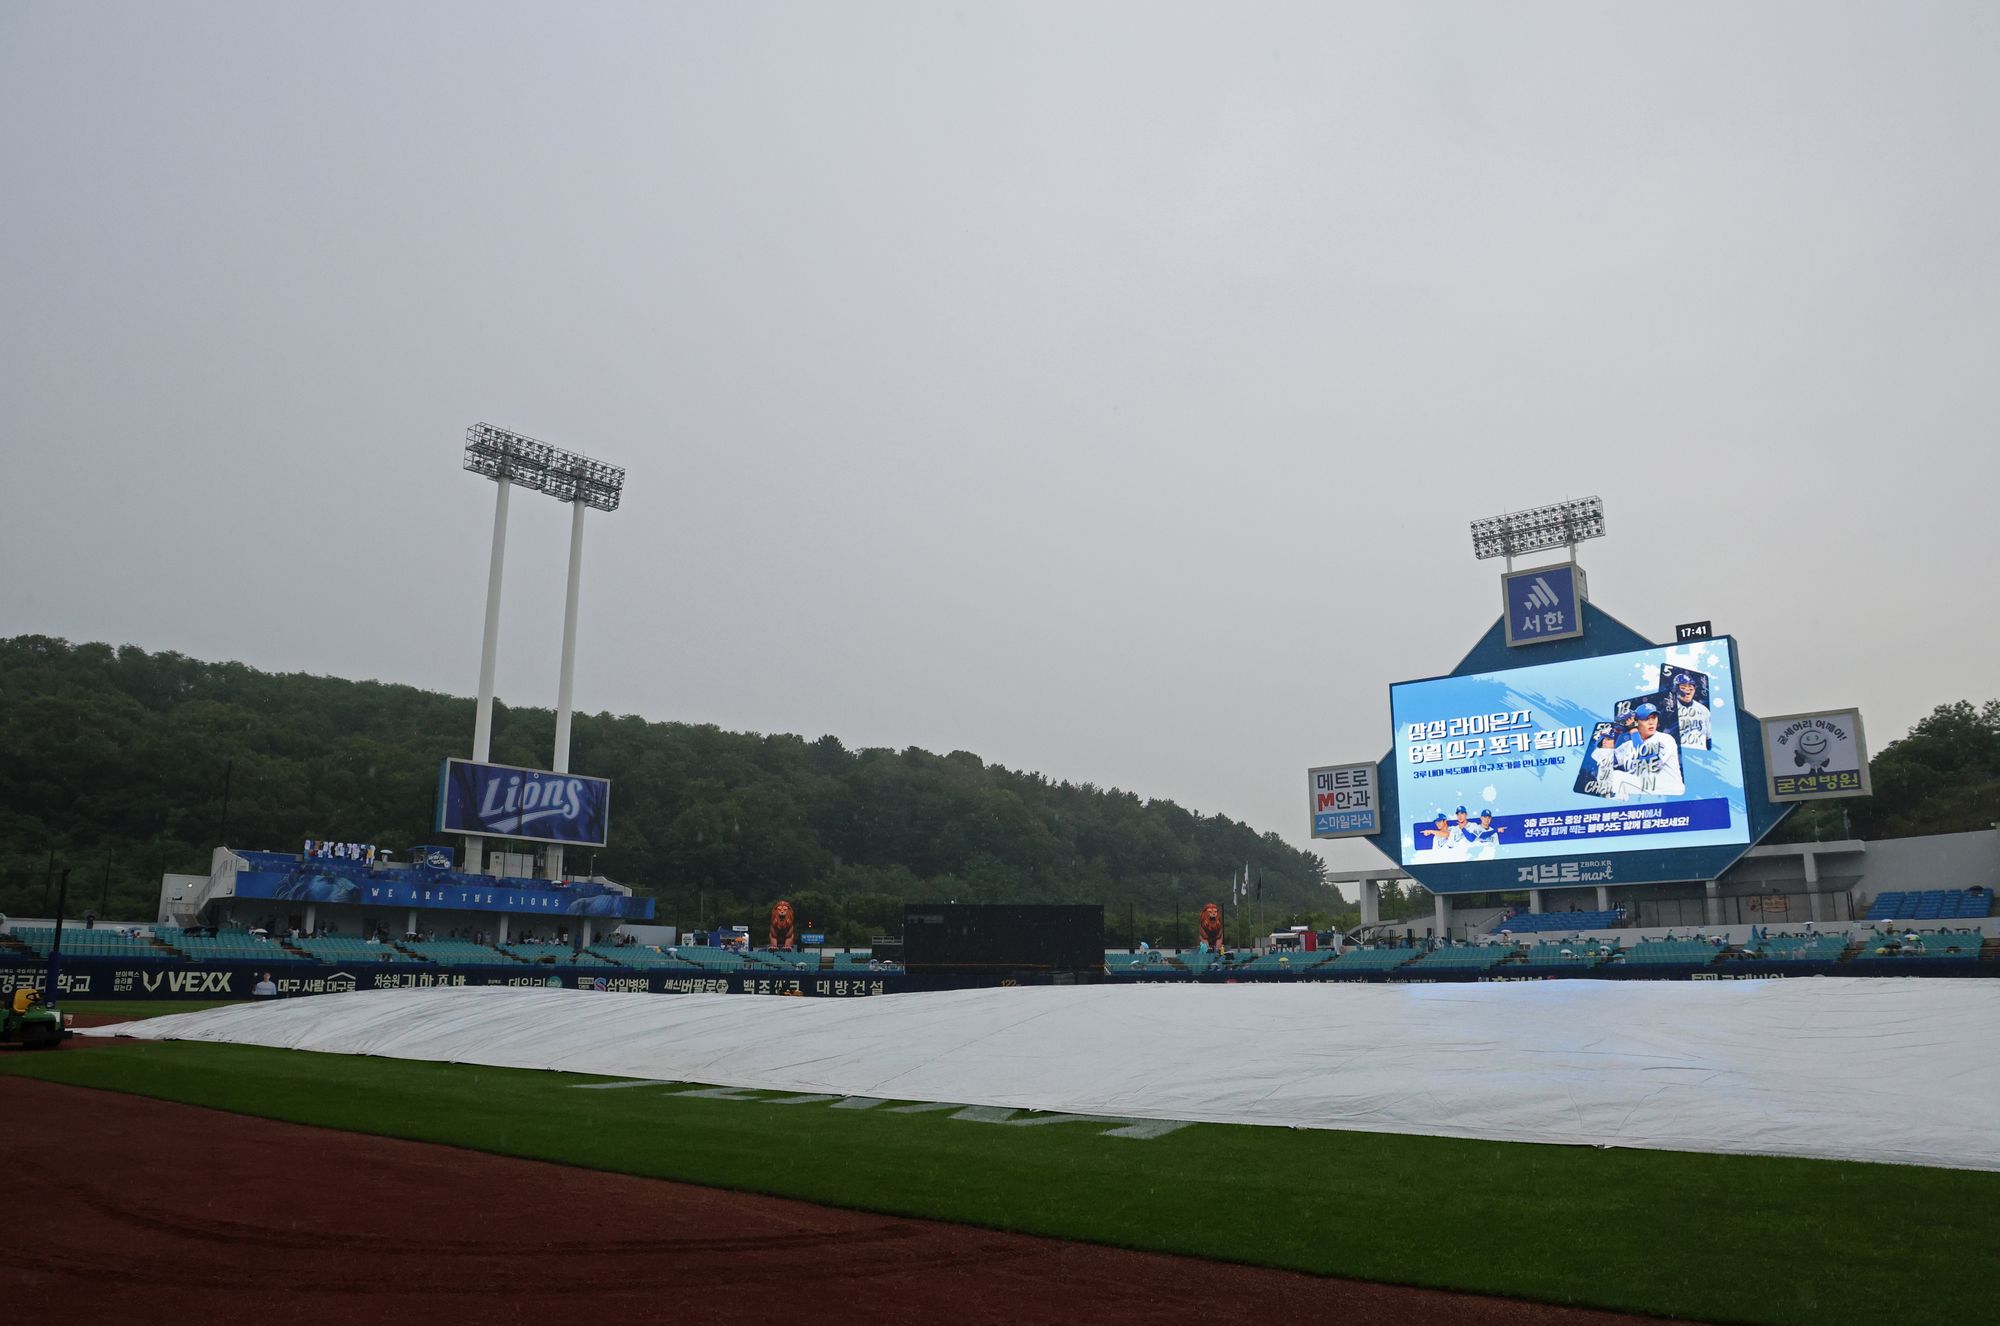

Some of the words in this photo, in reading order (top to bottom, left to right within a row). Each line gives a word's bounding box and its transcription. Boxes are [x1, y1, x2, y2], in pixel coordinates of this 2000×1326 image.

[1522, 610, 1565, 633] 서한
[1680, 625, 1707, 638] 17:41
[1662, 665, 1674, 677] 5
[1408, 719, 1448, 742] 삼성
[1449, 709, 1533, 738] 라이온즈
[1815, 720, 1848, 741] 어깨야!
[1408, 743, 1443, 764] 6월
[1446, 737, 1487, 761] 신규
[1488, 732, 1532, 757] 포카
[1534, 725, 1585, 751] 출시!
[1413, 770, 1427, 779] 3루
[1428, 768, 1444, 778] 내야
[1479, 762, 1495, 773] 신규
[1496, 760, 1521, 771] 포카를
[1522, 755, 1566, 768] 만나보세요
[1316, 769, 1369, 791] 메트로
[1777, 772, 1859, 793] 굳센병원
[478, 775, 583, 820] Lions
[1318, 813, 1372, 830] 스마일라식
[1523, 818, 1537, 828] 3층
[1538, 816, 1563, 827] 콘코스
[1564, 814, 1582, 825] 중앙
[1583, 813, 1601, 823] 라팍
[1602, 808, 1662, 822] 블루스퀘어에서
[1525, 827, 1549, 838] 선수와
[1551, 825, 1568, 836] 함께
[1623, 820, 1641, 831] 함께
[1642, 816, 1690, 829] 즐겨보세요!
[1517, 862, 1581, 884] 지브로
[1581, 866, 1614, 881] mart
[371, 887, 393, 898] WE
[411, 890, 444, 901] ARE
[461, 893, 493, 904] THE
[509, 896, 559, 907] LIONS
[168, 971, 232, 992] VEXX
[277, 979, 300, 993] 대구
[302, 979, 325, 993] 사람
[326, 980, 357, 993] 대구로
[374, 974, 400, 988] 차승원
[606, 978, 649, 993] 삼일병원
[816, 980, 884, 996] 대방건설
